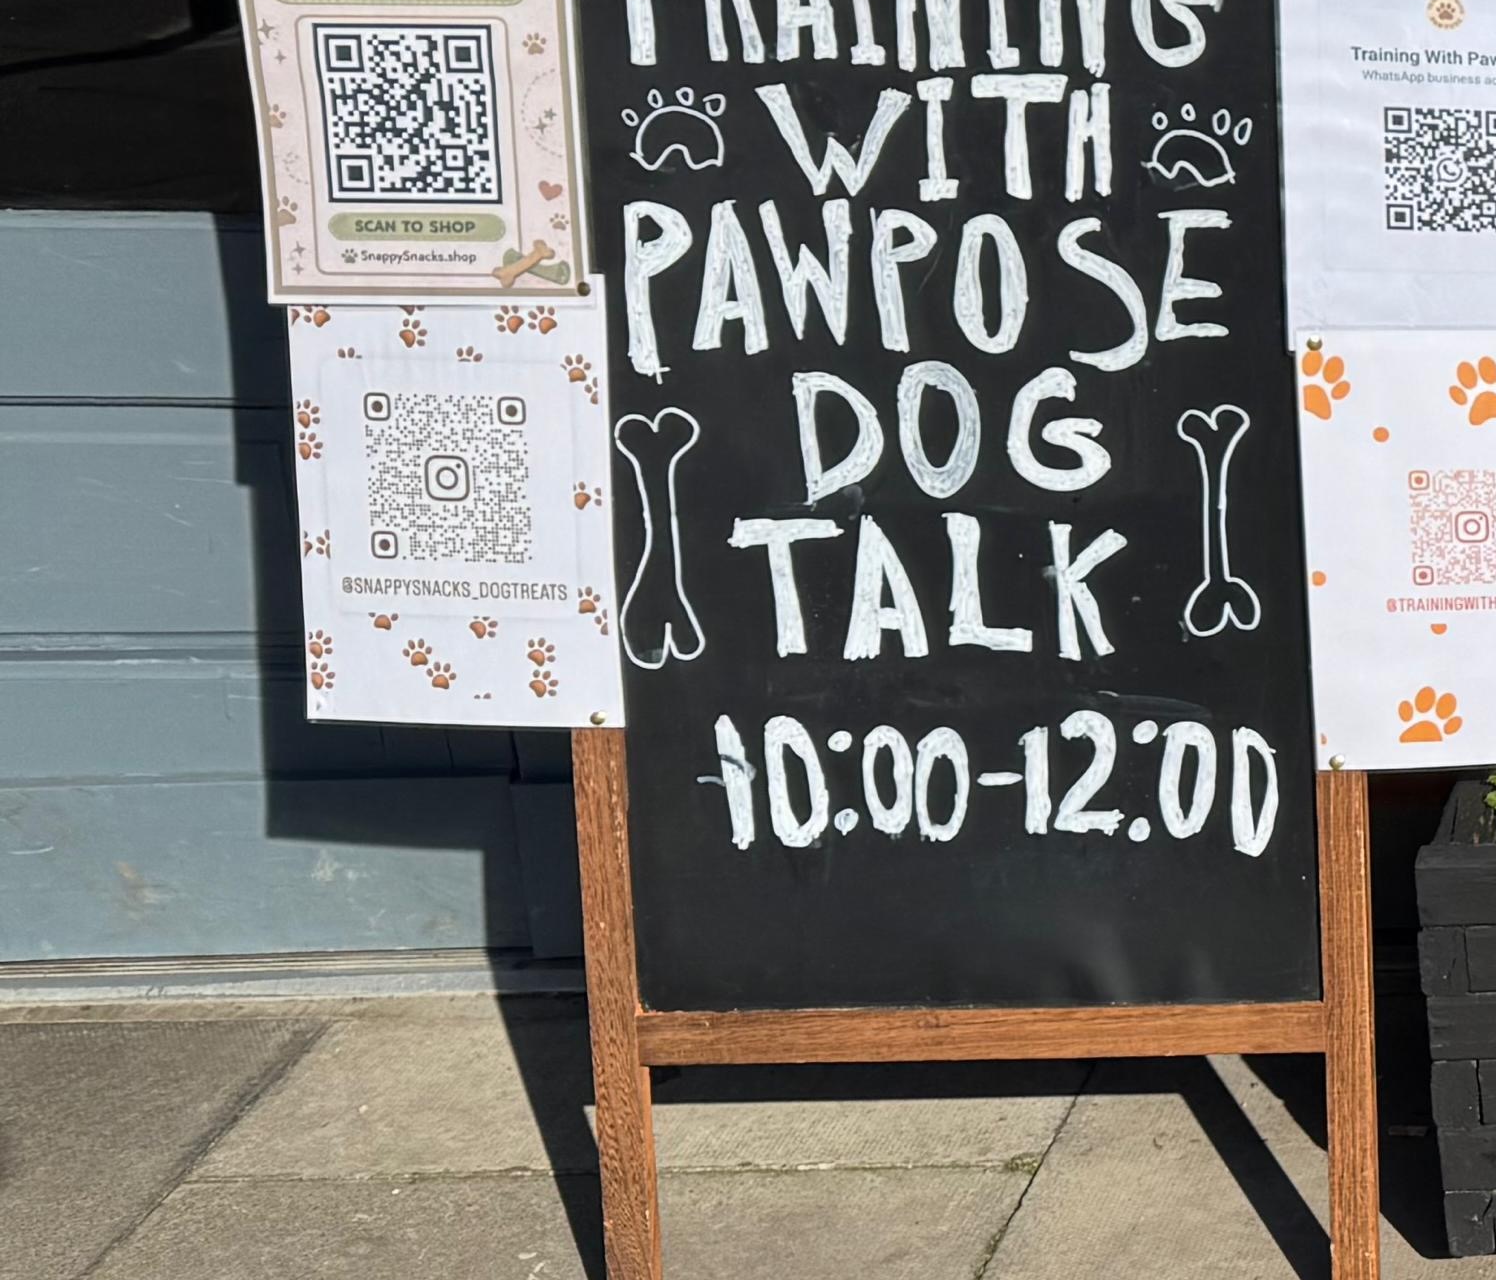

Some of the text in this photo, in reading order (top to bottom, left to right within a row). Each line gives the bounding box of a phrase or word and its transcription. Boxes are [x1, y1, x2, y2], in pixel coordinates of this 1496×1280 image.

[1351, 46, 1420, 66] Training
[1425, 49, 1463, 66] With
[1362, 70, 1425, 84] WhatsApp
[1427, 71, 1481, 85] business
[756, 74, 1111, 201] WITH
[354, 219, 476, 234] SCAN TO SHOP
[360, 249, 477, 265] SnappySnacks.shop
[622, 198, 1233, 385] PAWPOSE
[792, 360, 1112, 507] DOG
[342, 576, 568, 601] @SNAPPYSNACKS_DOGTREATS
[728, 511, 1128, 661] TALK
